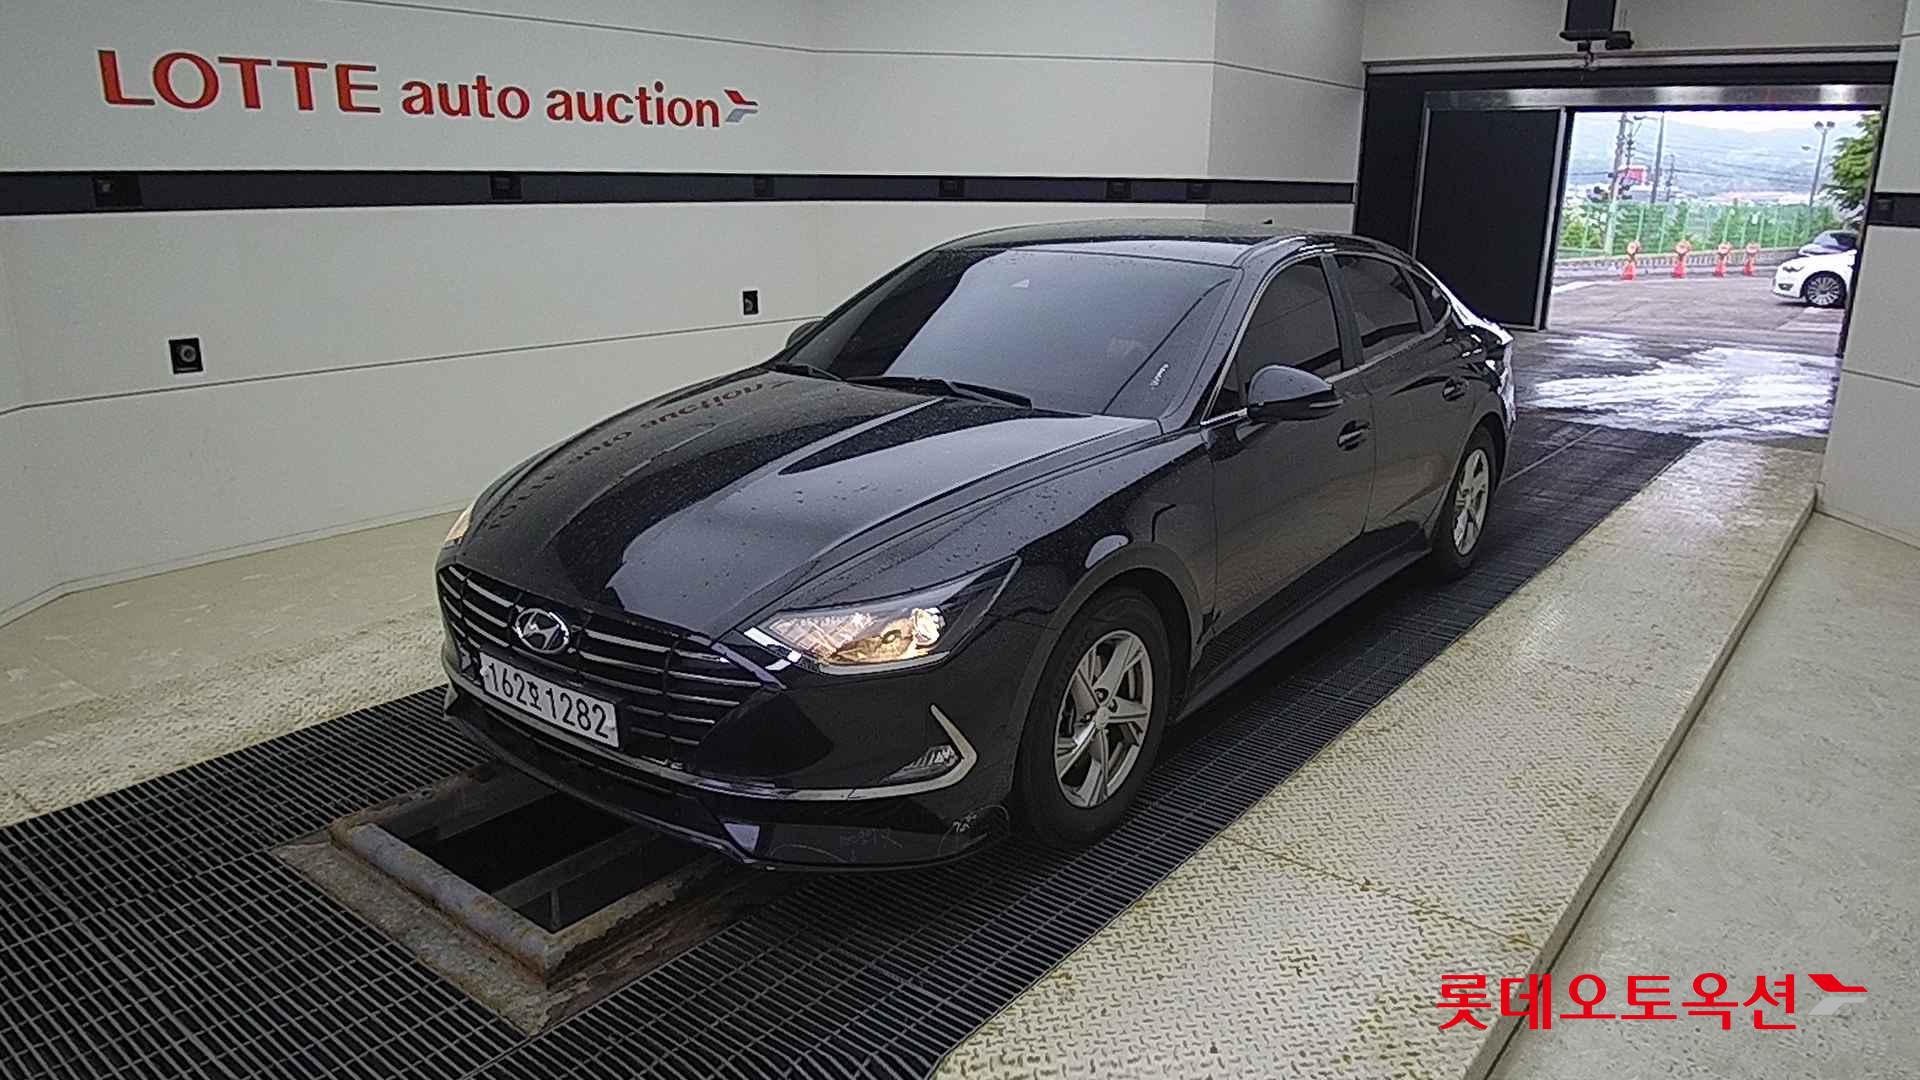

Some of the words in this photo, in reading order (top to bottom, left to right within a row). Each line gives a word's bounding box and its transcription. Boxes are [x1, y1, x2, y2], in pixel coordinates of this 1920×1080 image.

[98, 50, 380, 113] LOTTE
[401, 75, 529, 119] auto
[547, 81, 720, 127] auction
